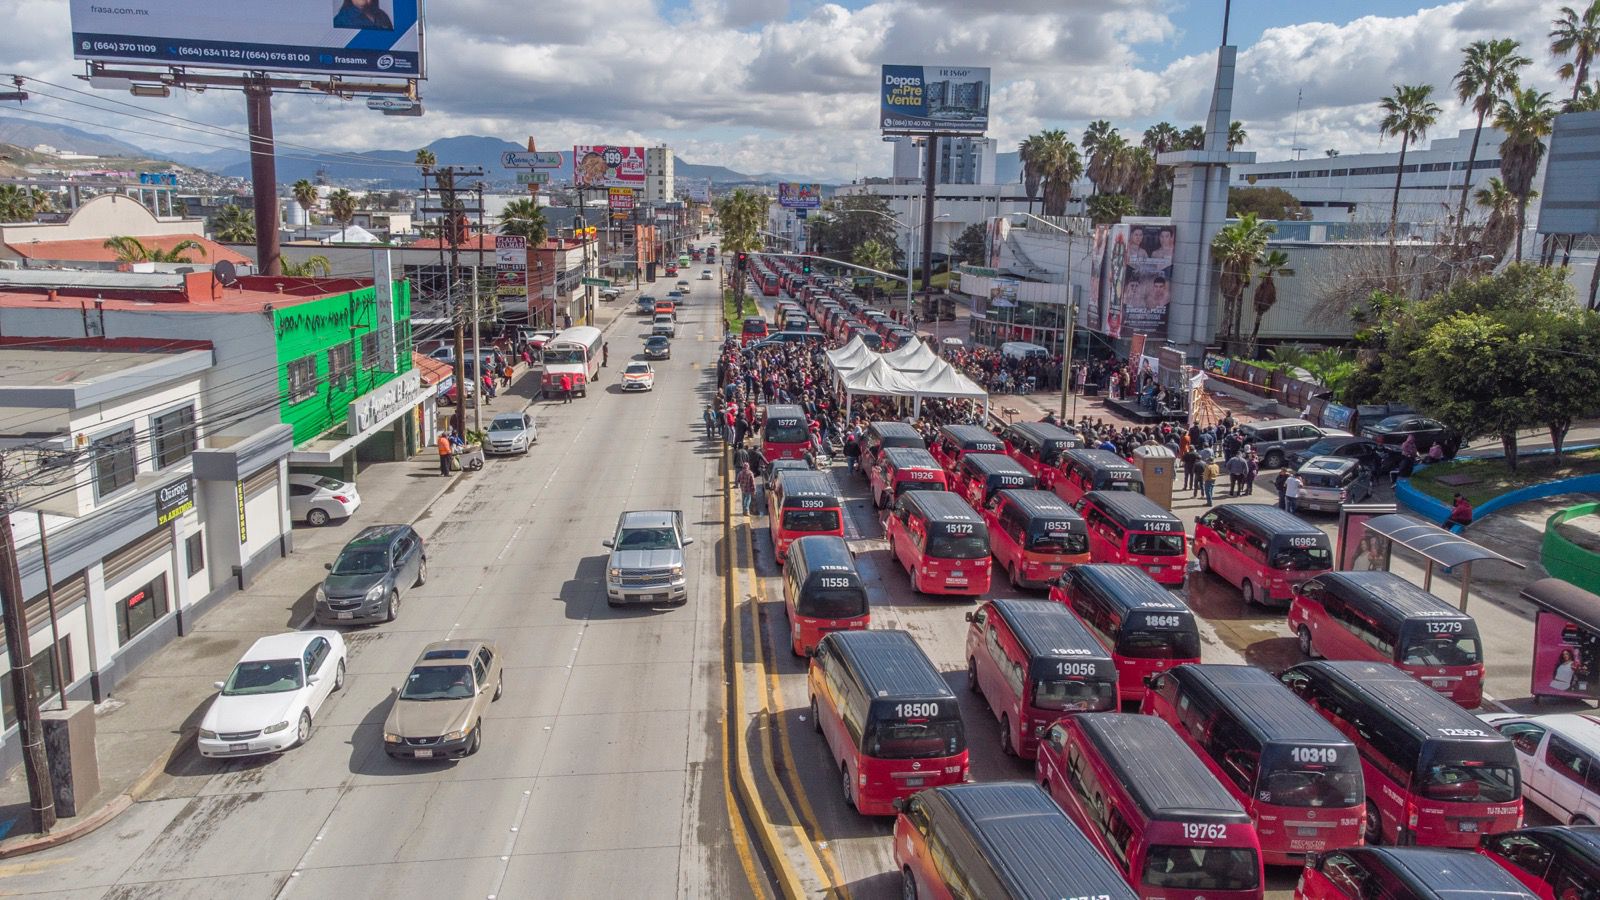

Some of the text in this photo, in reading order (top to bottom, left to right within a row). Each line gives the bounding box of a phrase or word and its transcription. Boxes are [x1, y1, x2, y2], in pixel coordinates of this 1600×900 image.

[90, 4, 150, 16] frasa.com.mx
[93, 41, 156, 53] (664) 370 1109
[178, 46, 202, 57] (664)
[203, 48, 220, 57] 634
[229, 50, 240, 58] 22
[246, 51, 269, 61] (664)
[270, 53, 287, 61] 676
[297, 53, 311, 63] 00
[334, 56, 368, 65] frasamx
[885, 74, 921, 88] Depas
[903, 85, 923, 96] Pre
[886, 94, 922, 106] Venta
[605, 152, 621, 164] 199
[377, 252, 392, 370] FARMACIA
[1001, 476, 1024, 484] 11108
[1109, 471, 1132, 479] 12172
[801, 500, 824, 508] 13950
[945, 523, 973, 534] 15172
[1044, 521, 1071, 531] 18531
[1144, 522, 1171, 532] 11478
[1289, 537, 1317, 547] 16962
[821, 577, 849, 588] 11558
[1145, 615, 1180, 627] 18645
[1426, 622, 1462, 633] 13279
[1056, 662, 1096, 676] 19056
[895, 703, 939, 717] 18500
[1291, 747, 1337, 763] 10319
[1182, 822, 1227, 839] 19762
